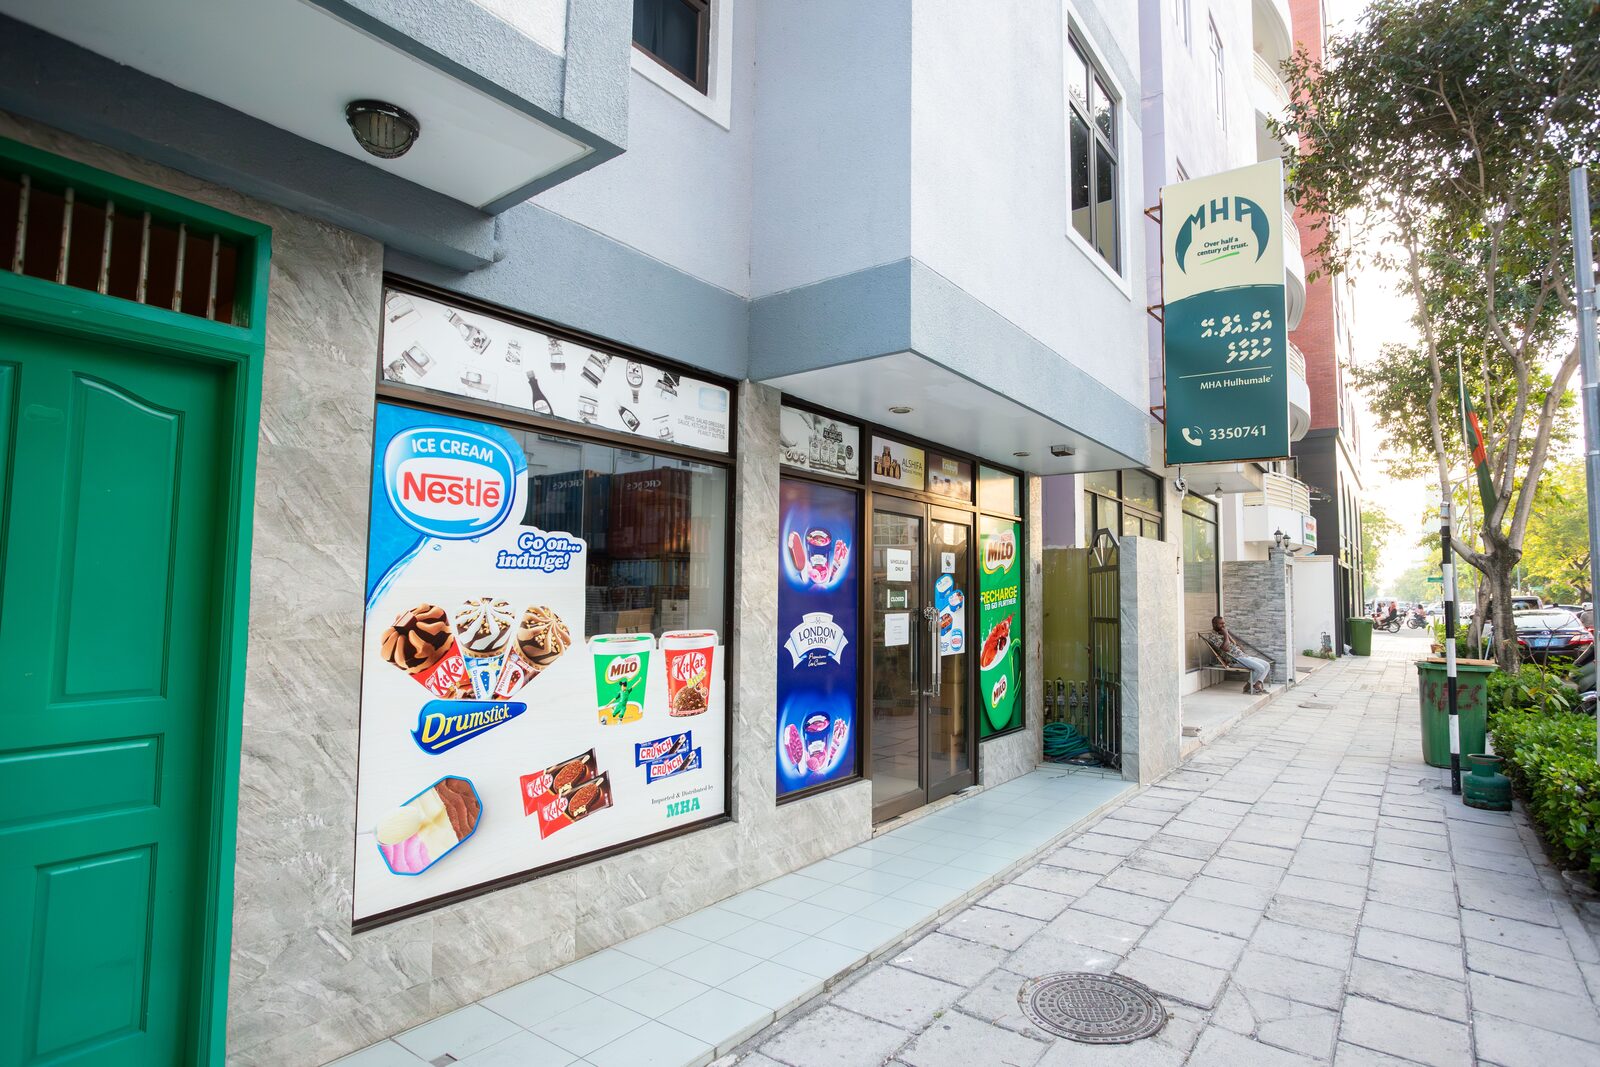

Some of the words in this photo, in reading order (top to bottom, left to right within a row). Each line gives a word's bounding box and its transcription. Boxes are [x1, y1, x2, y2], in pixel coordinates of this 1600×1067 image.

[1197, 246, 1221, 257] century
[1230, 241, 1249, 250] trust.
[1221, 237, 1233, 245] half
[1200, 381, 1222, 390] MHA
[1209, 424, 1267, 440] 3350741
[411, 438, 436, 453] ICE
[439, 438, 494, 463] CREAM
[518, 534, 543, 550] Go
[545, 538, 581, 552] on...
[988, 542, 1014, 562] MILO
[497, 550, 571, 572] indulge!
[981, 586, 1017, 604] RECHARGE
[984, 603, 991, 611] TO
[991, 601, 998, 610] GO
[799, 626, 837, 642] LONDON
[807, 636, 828, 646] DAIRY
[610, 661, 638, 677] MILO
[421, 704, 510, 743] Drumstick
[640, 738, 673, 759] CRUNCH
[651, 756, 683, 776] CRUNCH
[651, 793, 675, 805] Imported
[707, 784, 714, 793] by
[666, 797, 701, 818] MHA
